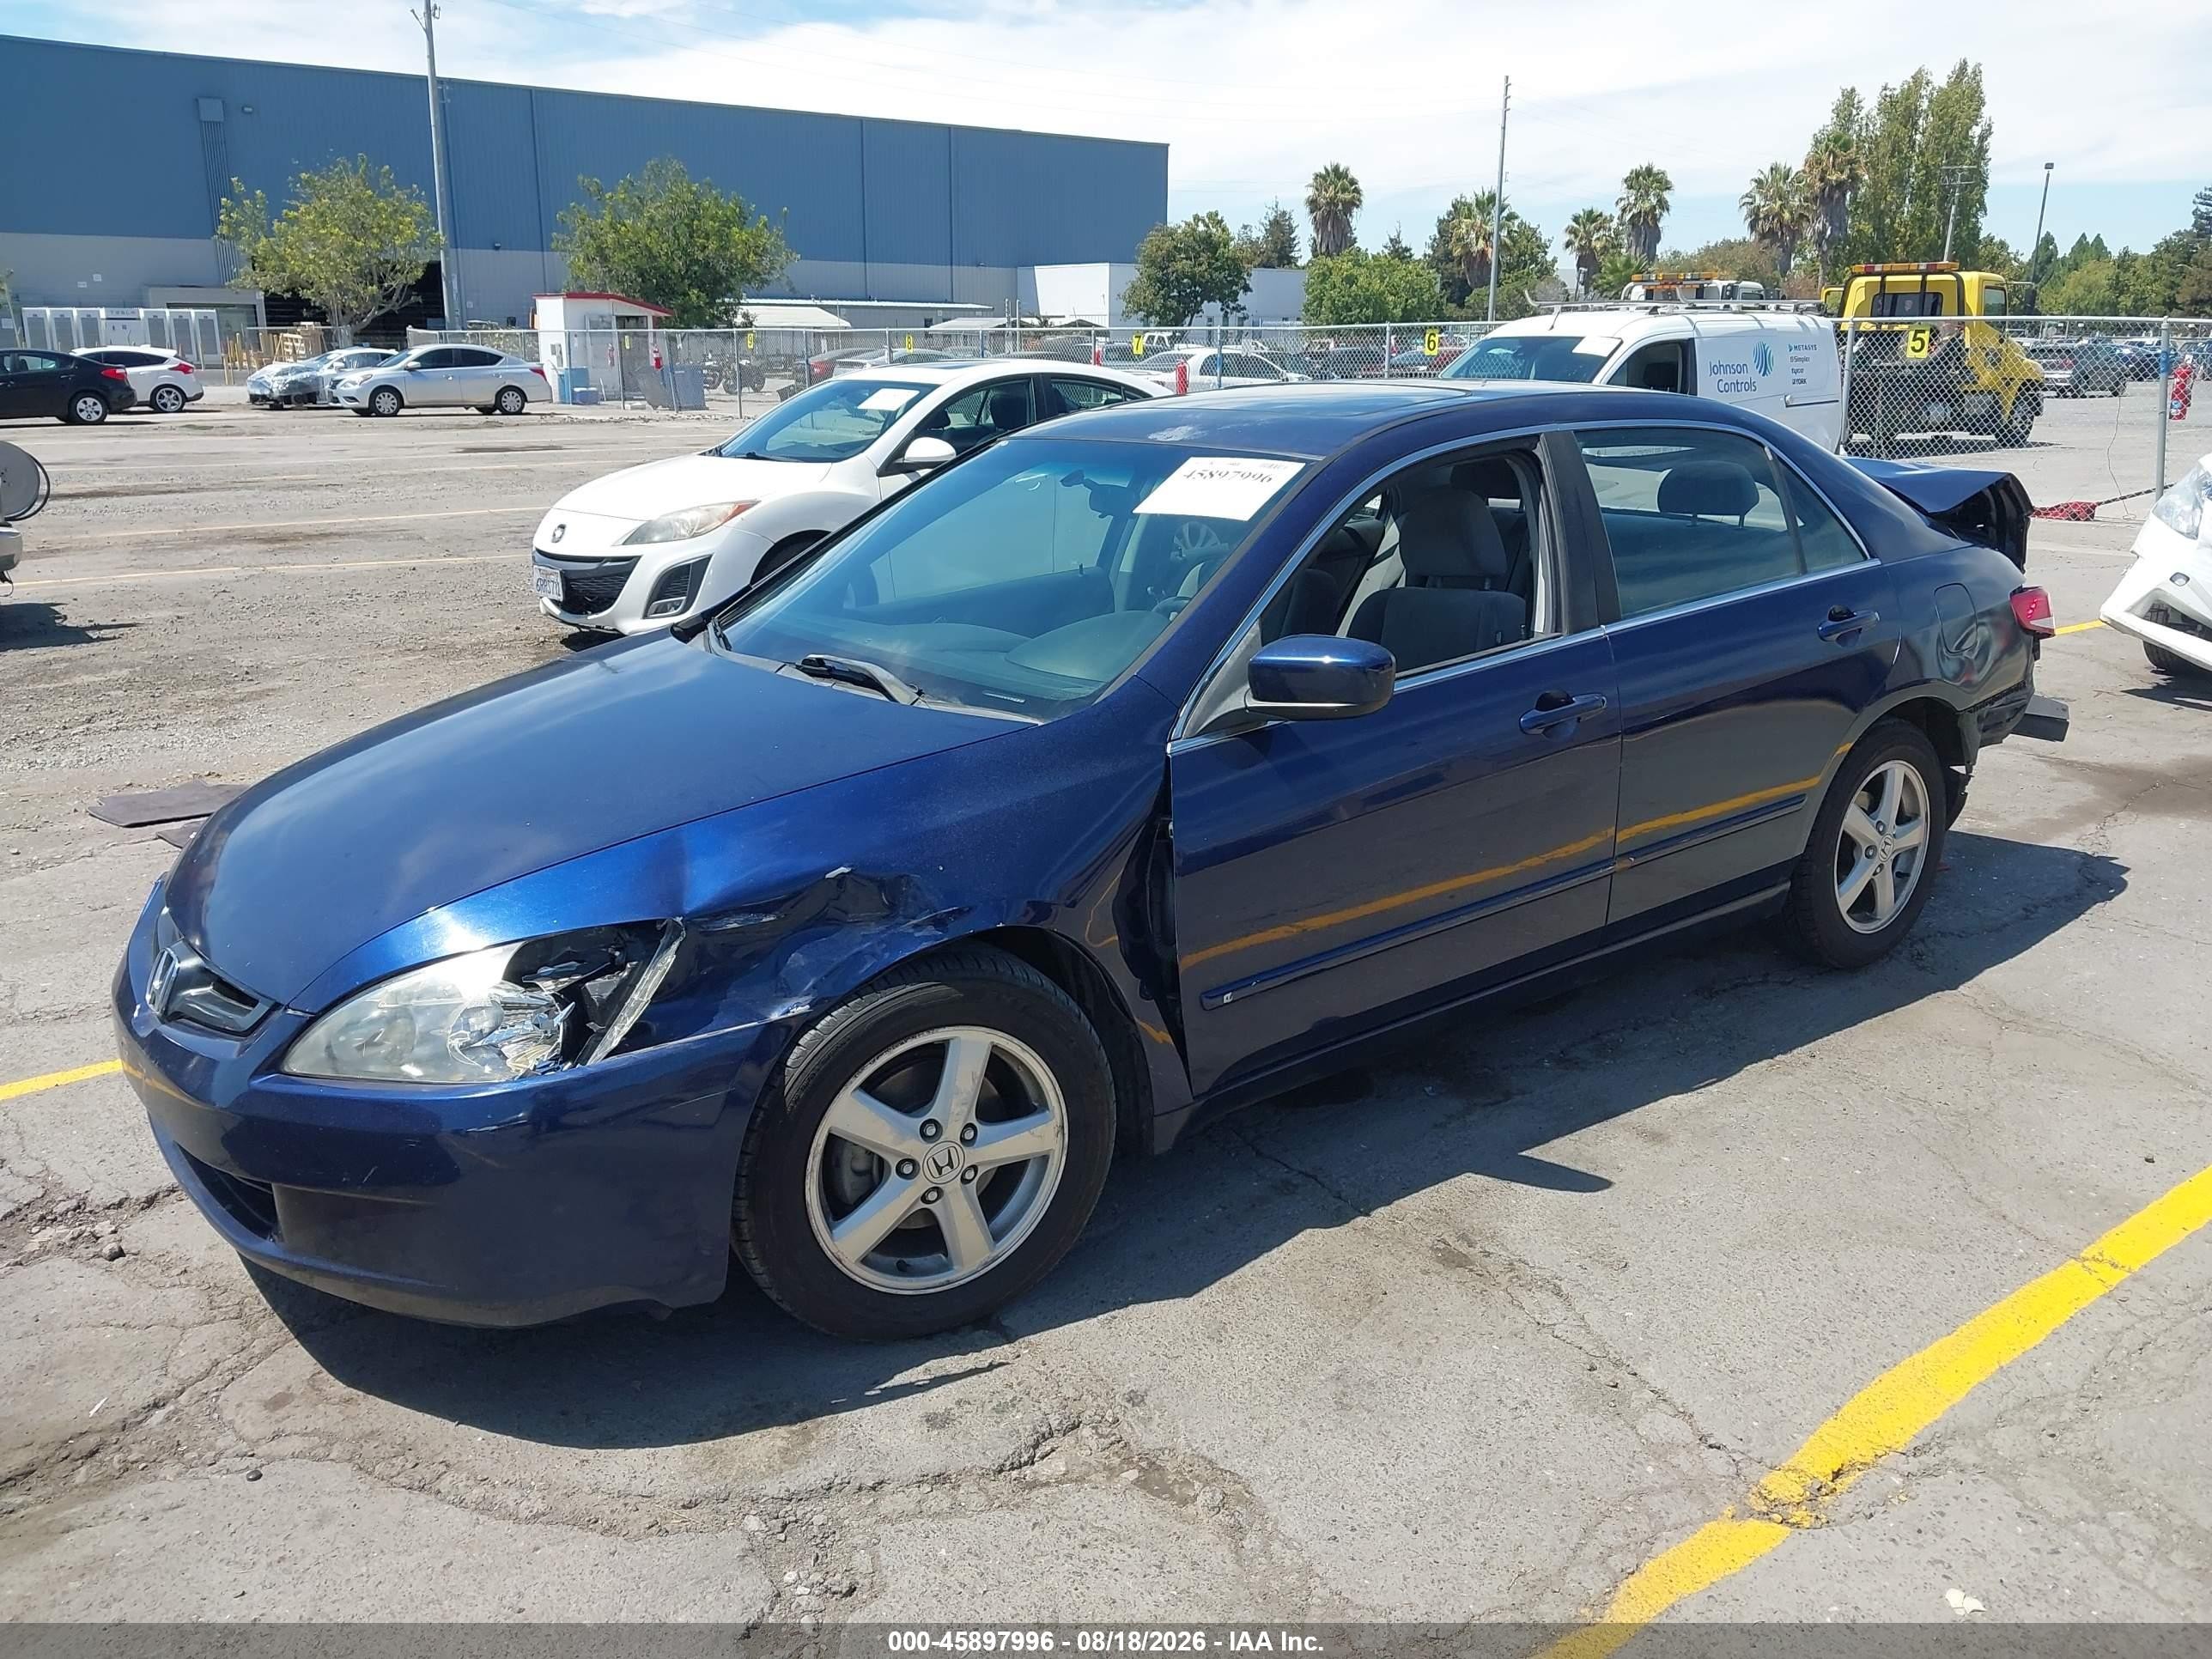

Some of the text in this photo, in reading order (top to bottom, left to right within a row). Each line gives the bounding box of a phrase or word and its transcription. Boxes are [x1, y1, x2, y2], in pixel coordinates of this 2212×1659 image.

[907, 336, 912, 350] 8
[1134, 335, 1142, 351] 7
[1427, 332, 1437, 351] 6
[1911, 329, 1926, 353] 5
[1709, 360, 1748, 376] Johnson
[1717, 377, 1757, 393] Controls
[1182, 468, 1273, 483] 45897996
